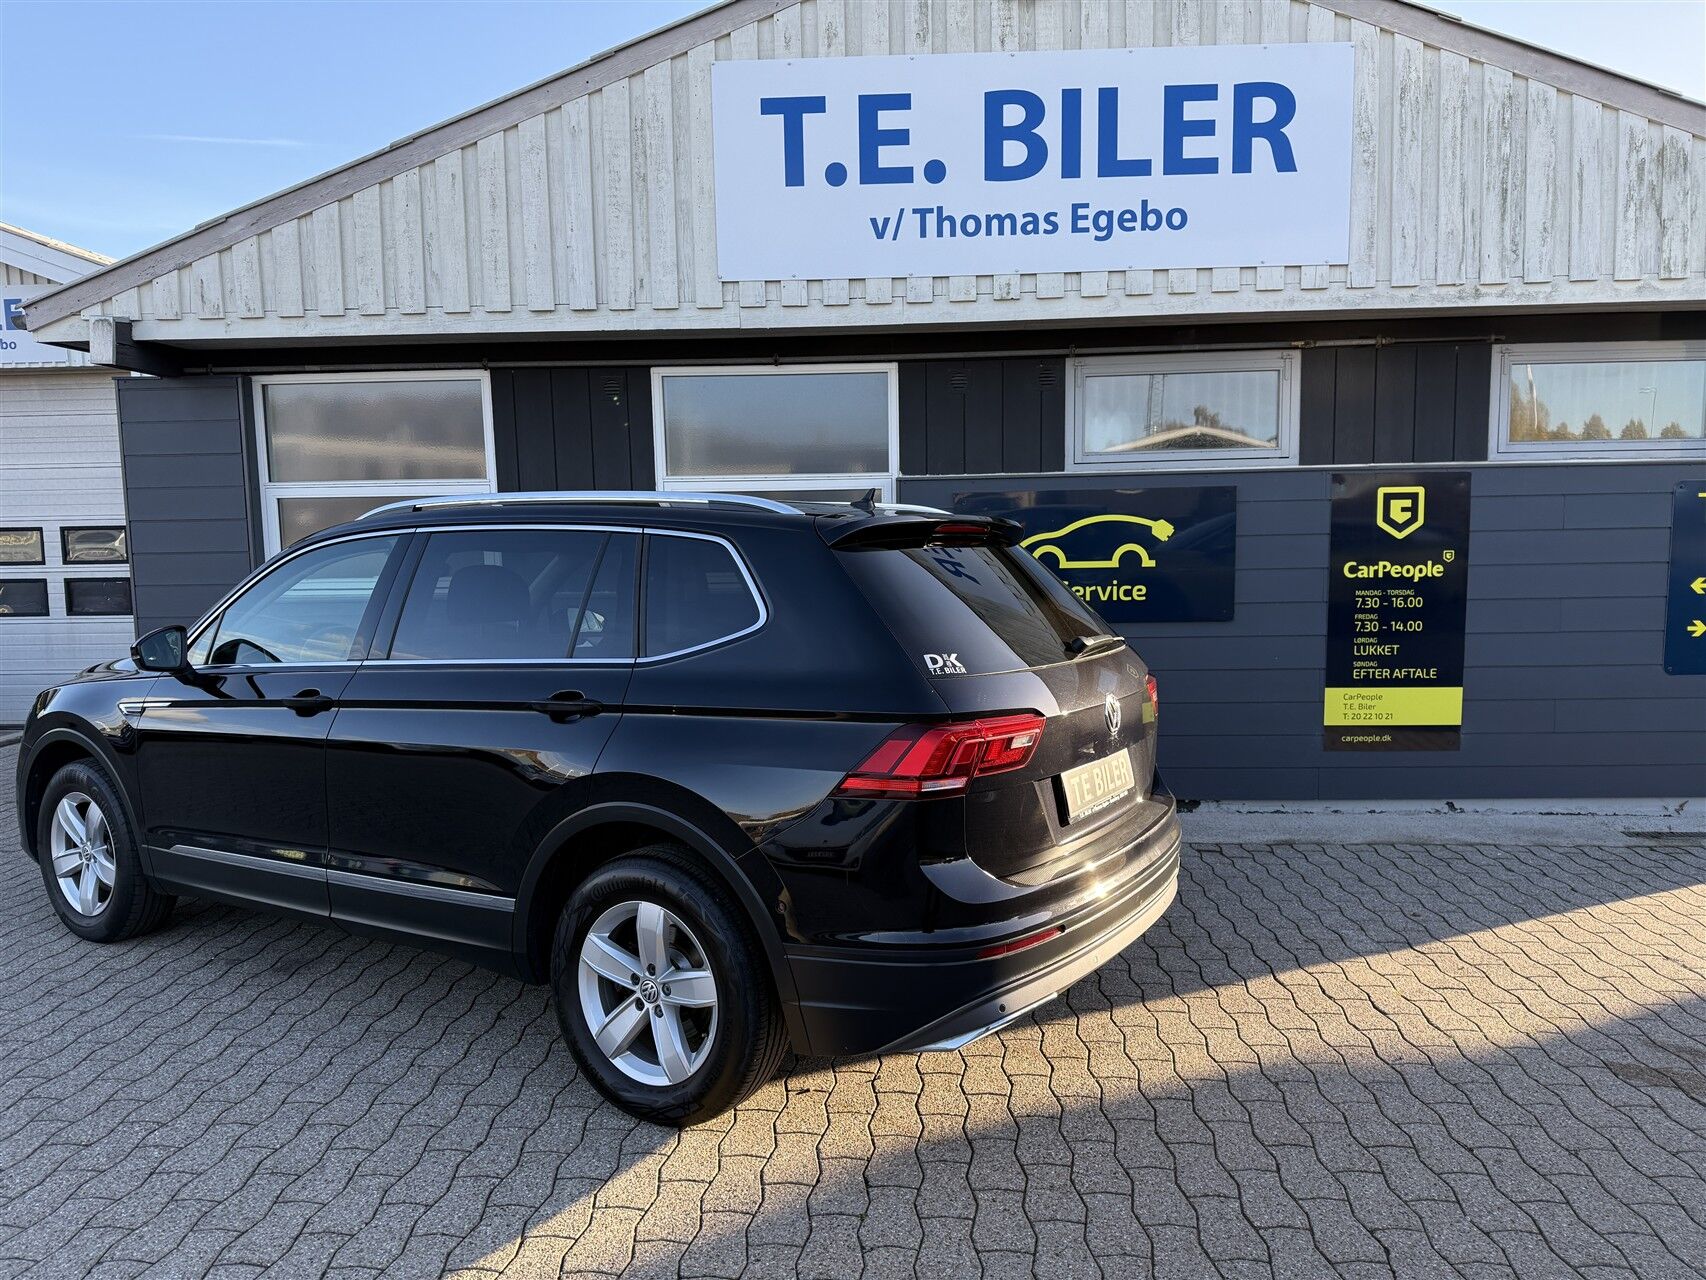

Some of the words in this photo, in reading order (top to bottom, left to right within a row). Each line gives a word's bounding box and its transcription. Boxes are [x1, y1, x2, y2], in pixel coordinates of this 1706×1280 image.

[760, 93, 947, 187] T.E.
[984, 82, 1298, 182] BILER
[869, 208, 905, 242] v/
[912, 207, 1060, 239] Thomas
[1071, 200, 1189, 242] Egebo
[1343, 561, 1444, 582] CarPeople
[1063, 580, 1147, 602] ervice
[1355, 598, 1380, 608] 7.30
[1392, 597, 1424, 608] 16.00
[1354, 621, 1379, 632] 7.30
[1390, 621, 1423, 632] 14.00
[1353, 645, 1400, 656] LUKKET
[1353, 669, 1390, 679] EFTER
[1392, 668, 1438, 679] AFTALE
[1343, 693, 1383, 703] CarPeople
[1343, 703, 1357, 711] T.E.
[1358, 703, 1377, 711] Biler
[1341, 734, 1392, 743] carpeople.dk
[1092, 757, 1130, 796] BILER
